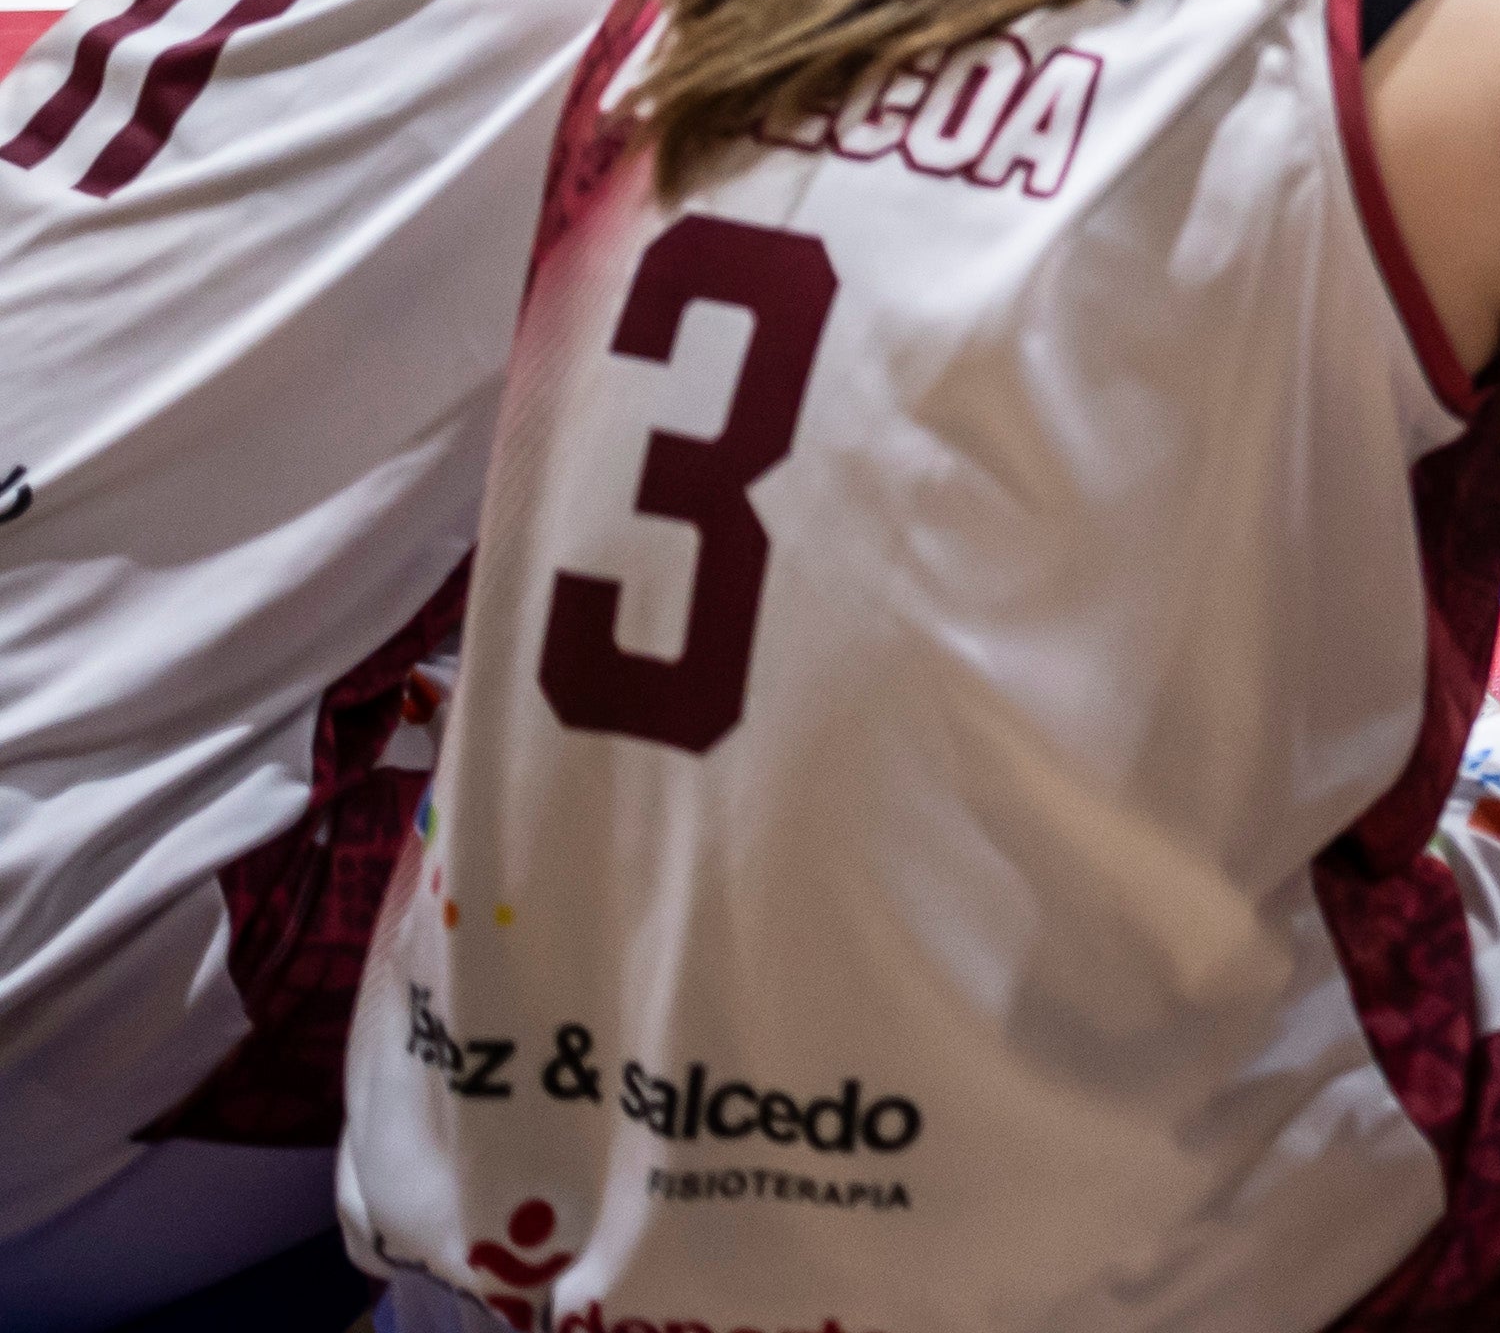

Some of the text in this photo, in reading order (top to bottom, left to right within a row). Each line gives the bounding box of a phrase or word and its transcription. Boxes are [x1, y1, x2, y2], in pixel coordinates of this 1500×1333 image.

[539, 213, 840, 755] 3
[619, 1058, 923, 1155] salcedo
[646, 1166, 912, 1212] FISIOTERAPIA
